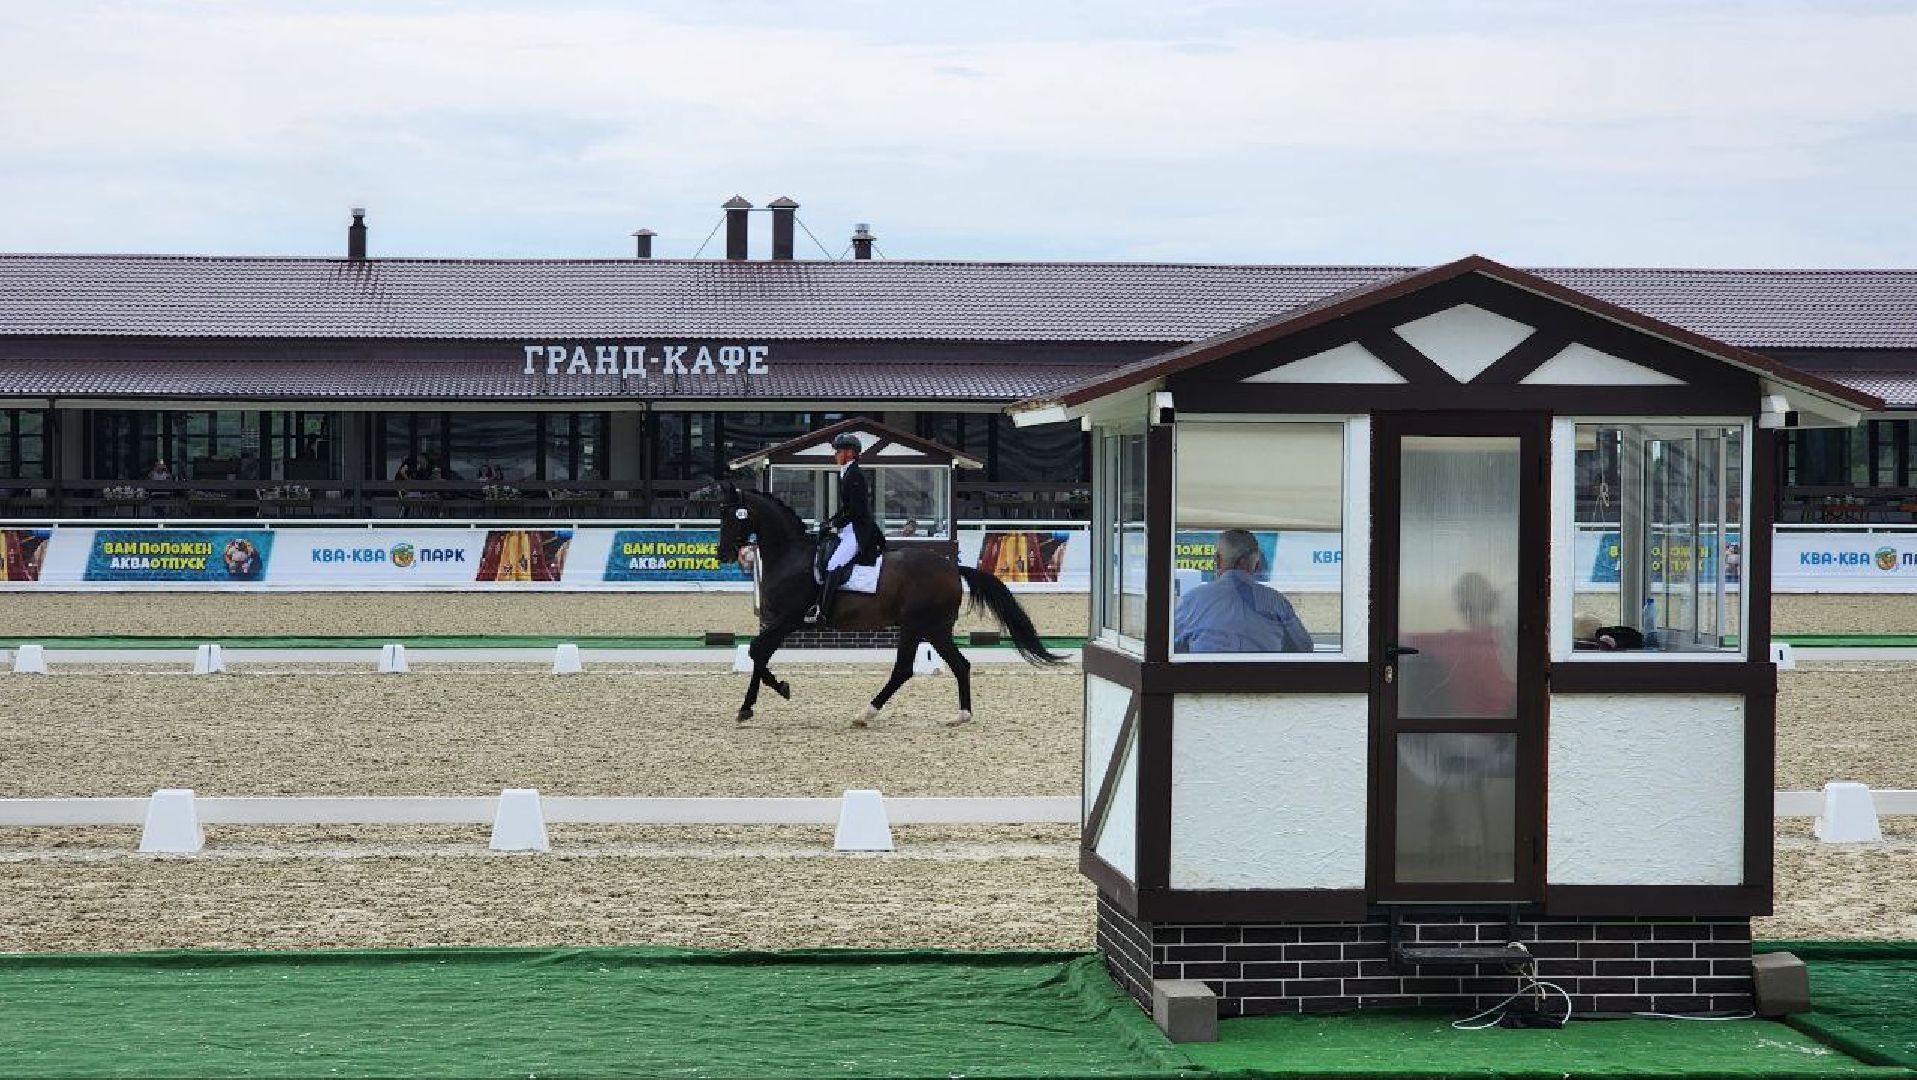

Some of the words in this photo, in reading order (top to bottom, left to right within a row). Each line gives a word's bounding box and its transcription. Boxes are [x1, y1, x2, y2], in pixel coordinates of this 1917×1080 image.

[524, 345, 768, 378] ГРАНД-КАФЕ
[103, 542, 136, 555] ВАМ
[419, 548, 465, 562] ПАРК
[623, 542, 654, 555] ВАМ
[656, 542, 719, 555] ПОЛОЖЕ
[110, 557, 206, 570] АКВАОТПУСК
[1902, 552, 1917, 565] П
